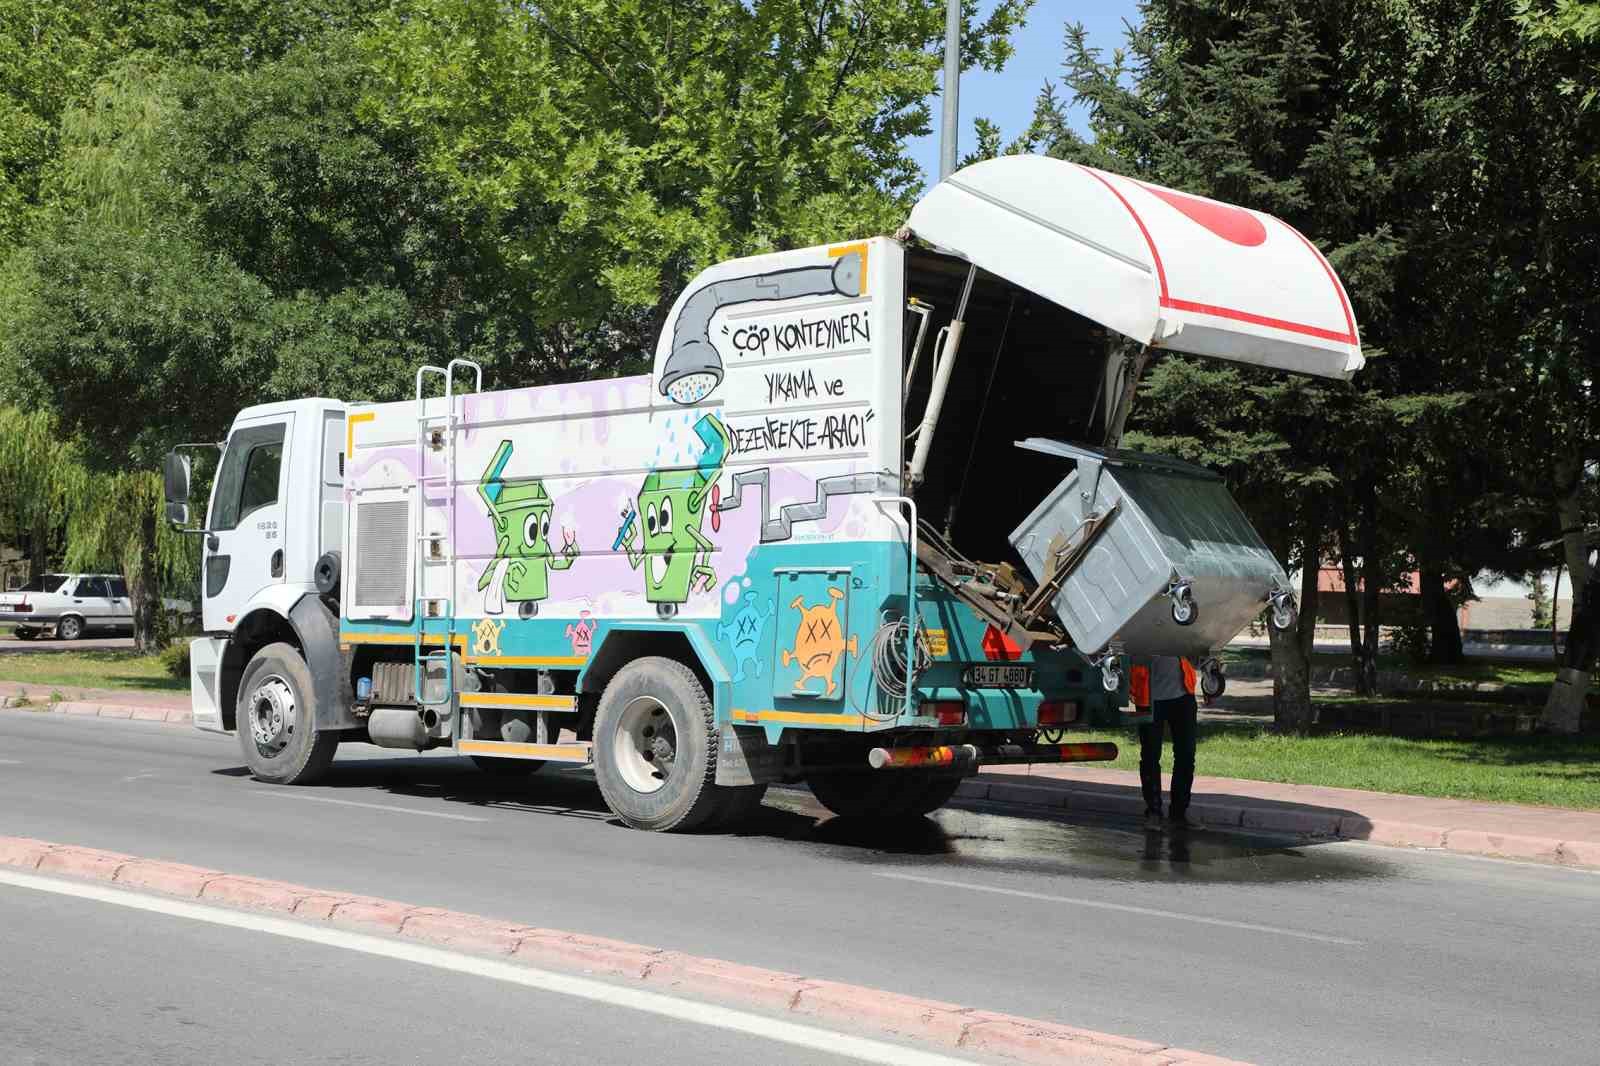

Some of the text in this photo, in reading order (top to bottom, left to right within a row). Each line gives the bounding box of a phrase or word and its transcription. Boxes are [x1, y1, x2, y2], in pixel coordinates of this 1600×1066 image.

[764, 369, 845, 404] YIKAMA ve
[975, 667, 986, 682] 34
[988, 667, 1000, 682] GT
